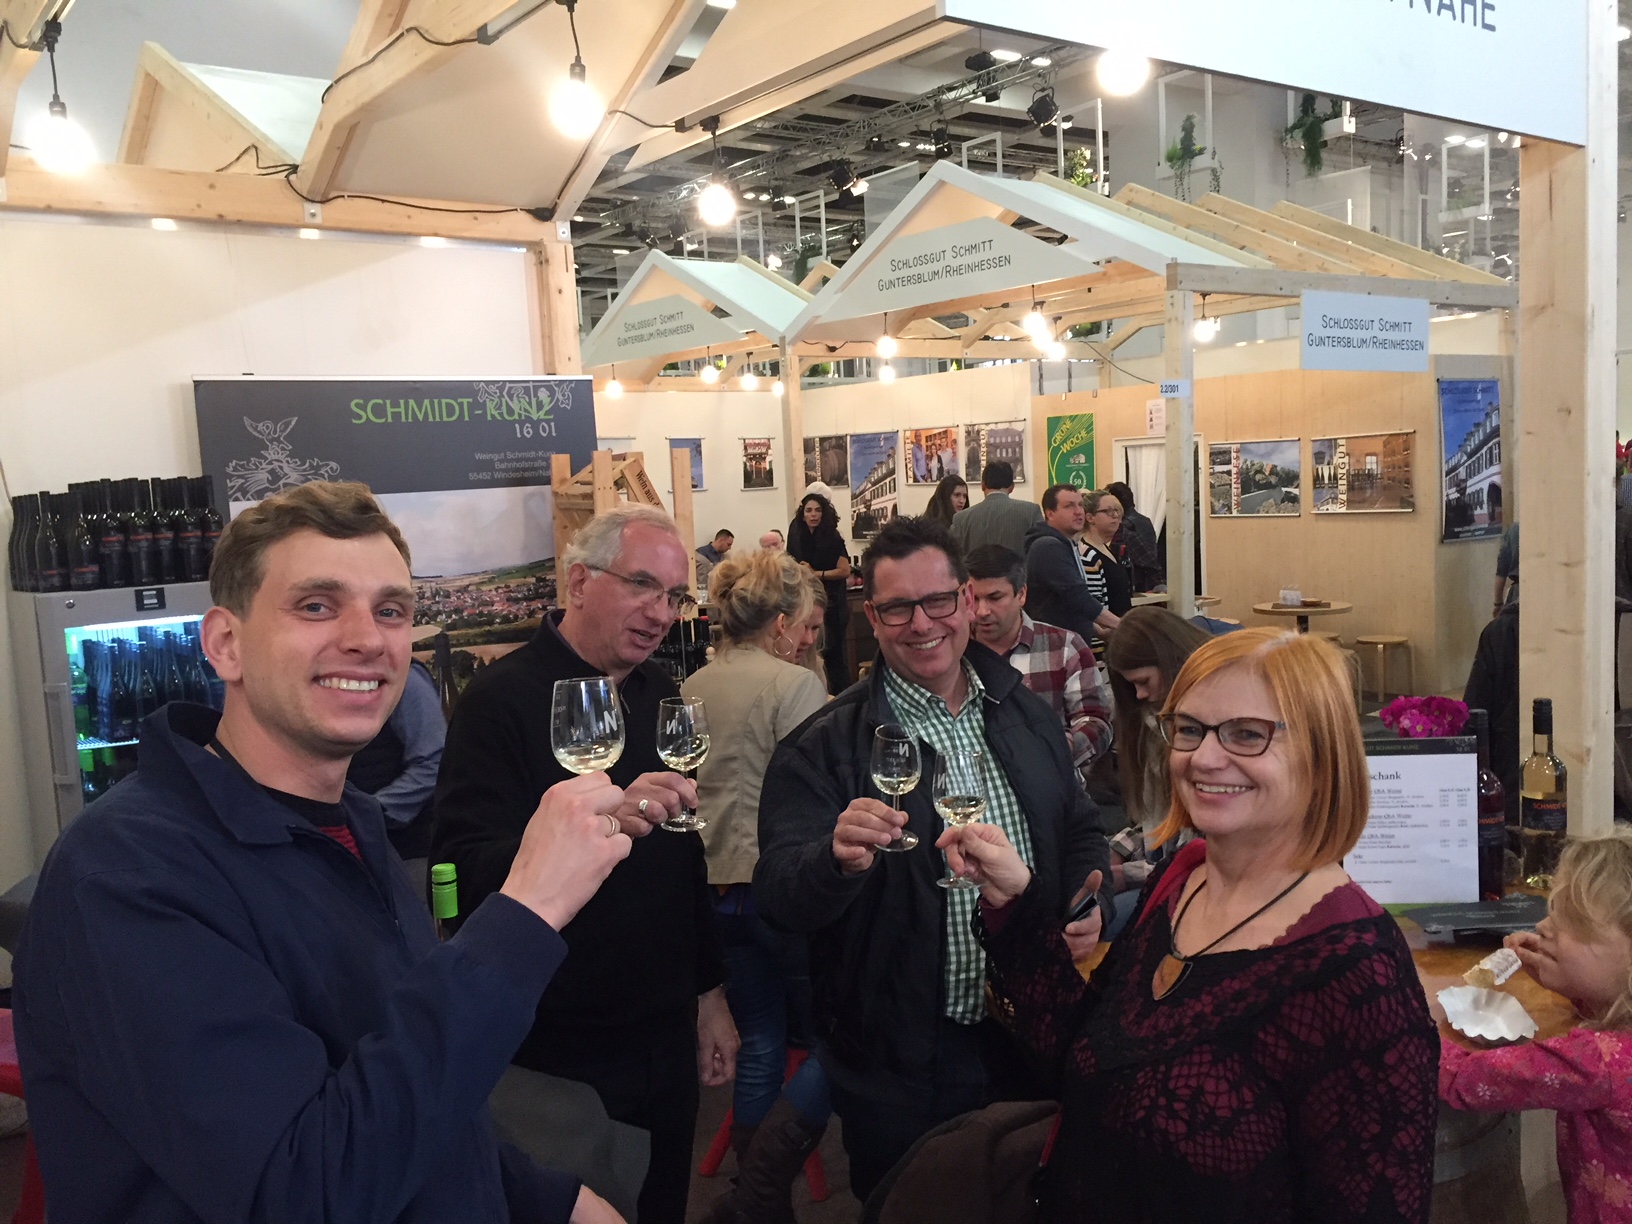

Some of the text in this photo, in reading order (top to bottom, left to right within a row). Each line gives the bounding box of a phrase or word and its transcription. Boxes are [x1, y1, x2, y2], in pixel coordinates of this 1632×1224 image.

[890, 239, 994, 272] SCHLOSSGUT SCHMITT
[877, 254, 1012, 292] GUNTERSBLUM/RHEINHESSEN
[623, 311, 684, 333] SCHLOSSGUT SCHMITT
[1321, 314, 1413, 332] SCHLOSSGUT SCHMITT
[617, 323, 695, 347] GUNTERSBLUM/RHEINHESSEN
[1307, 332, 1425, 351] GUNTERSBLUM/RHEINHESSEN
[350, 397, 555, 424] SCHMIDT-KUNZ
[514, 421, 557, 438] 16 01
[1060, 429, 1087, 453] WOCHE
[474, 451, 504, 460] Weingut
[494, 459, 547, 469] Bahnhofstraße
[905, 435, 913, 479] FAMILIE
[468, 471, 492, 480] 55452
[635, 469, 655, 503] Wein aus
[1232, 446, 1241, 510] WEINLESE
[1338, 441, 1347, 510] WEINGUT
[603, 710, 618, 734] N
